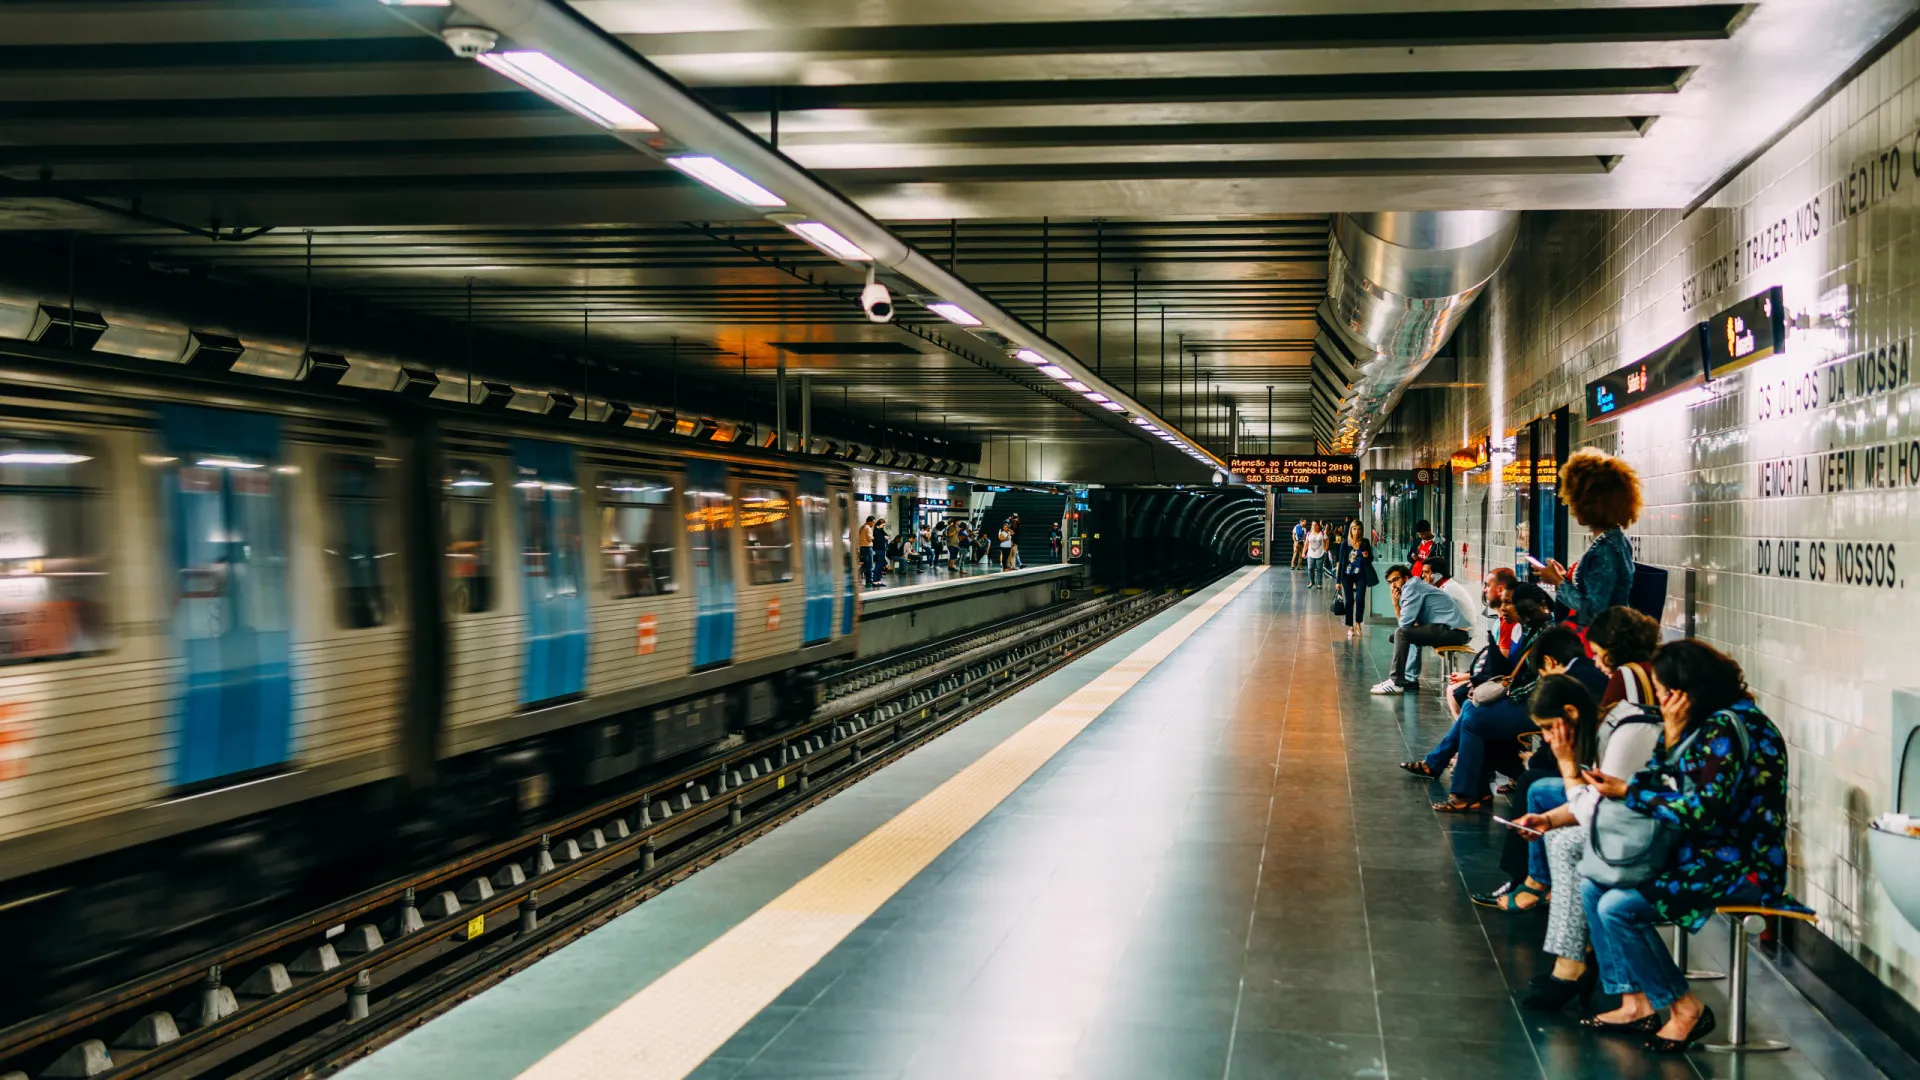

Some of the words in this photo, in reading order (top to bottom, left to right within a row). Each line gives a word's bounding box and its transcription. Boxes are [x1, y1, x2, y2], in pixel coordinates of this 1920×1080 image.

[1682, 276, 1697, 312] SER
[1701, 256, 1729, 301] AUTOR
[1734, 240, 1740, 283] É
[1832, 146, 1901, 226] INÉDITO
[1758, 384, 1771, 420] OS
[1779, 370, 1818, 416] OLHOS
[1828, 366, 1845, 403] DA
[1856, 342, 1909, 397] NOSSA
[1284, 459, 1327, 467] intervalo
[1328, 463, 1353, 471] 20:04
[1758, 451, 1809, 497] MEMÓRIA
[1819, 442, 1854, 494] VÊEM
[1758, 540, 1771, 575] DO
[1778, 540, 1800, 578] QUE
[1809, 541, 1826, 581] OS
[1836, 542, 1904, 589] NOSSOS.
